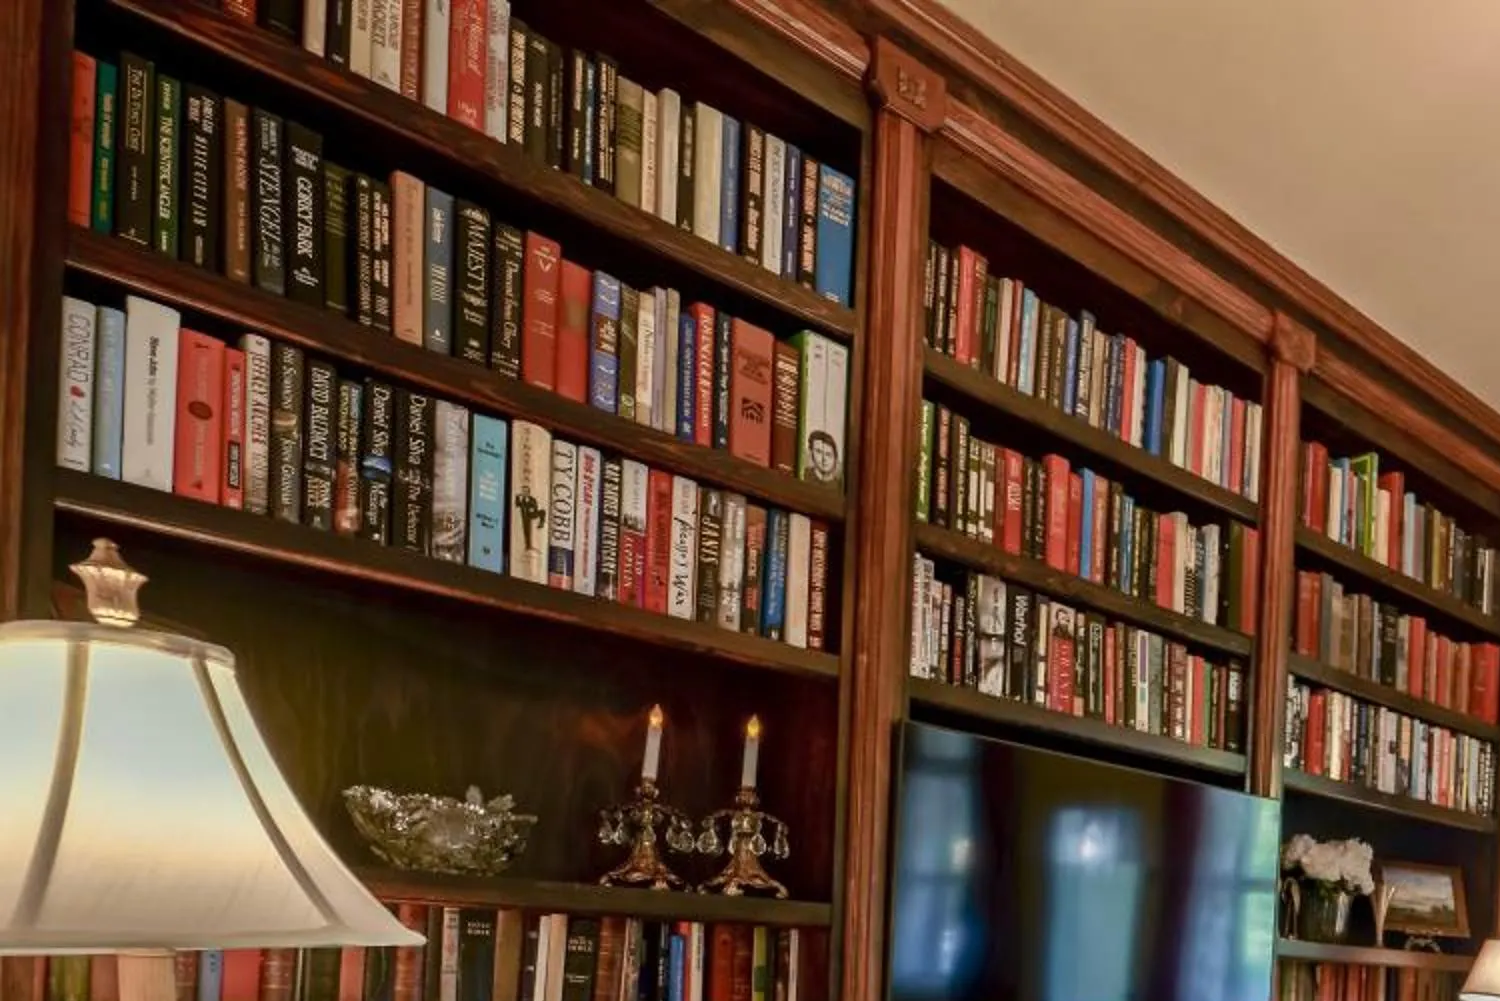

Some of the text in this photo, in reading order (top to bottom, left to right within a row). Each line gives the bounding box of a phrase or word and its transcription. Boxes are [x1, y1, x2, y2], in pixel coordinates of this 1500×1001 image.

[259, 157, 283, 242] STENGEL
[297, 176, 313, 219] GORKY
[297, 219, 313, 259] PARK
[467, 219, 485, 296] MAJESTY
[65, 313, 92, 385] CONRAD
[311, 367, 330, 403] DAVID
[372, 386, 391, 457] Daniel Silva
[408, 393, 427, 432] Daniel
[408, 438, 426, 465] Silva
[552, 448, 573, 541] TY COBB
[700, 516, 720, 564] JANIS
[1013, 595, 1028, 646] Warhol
